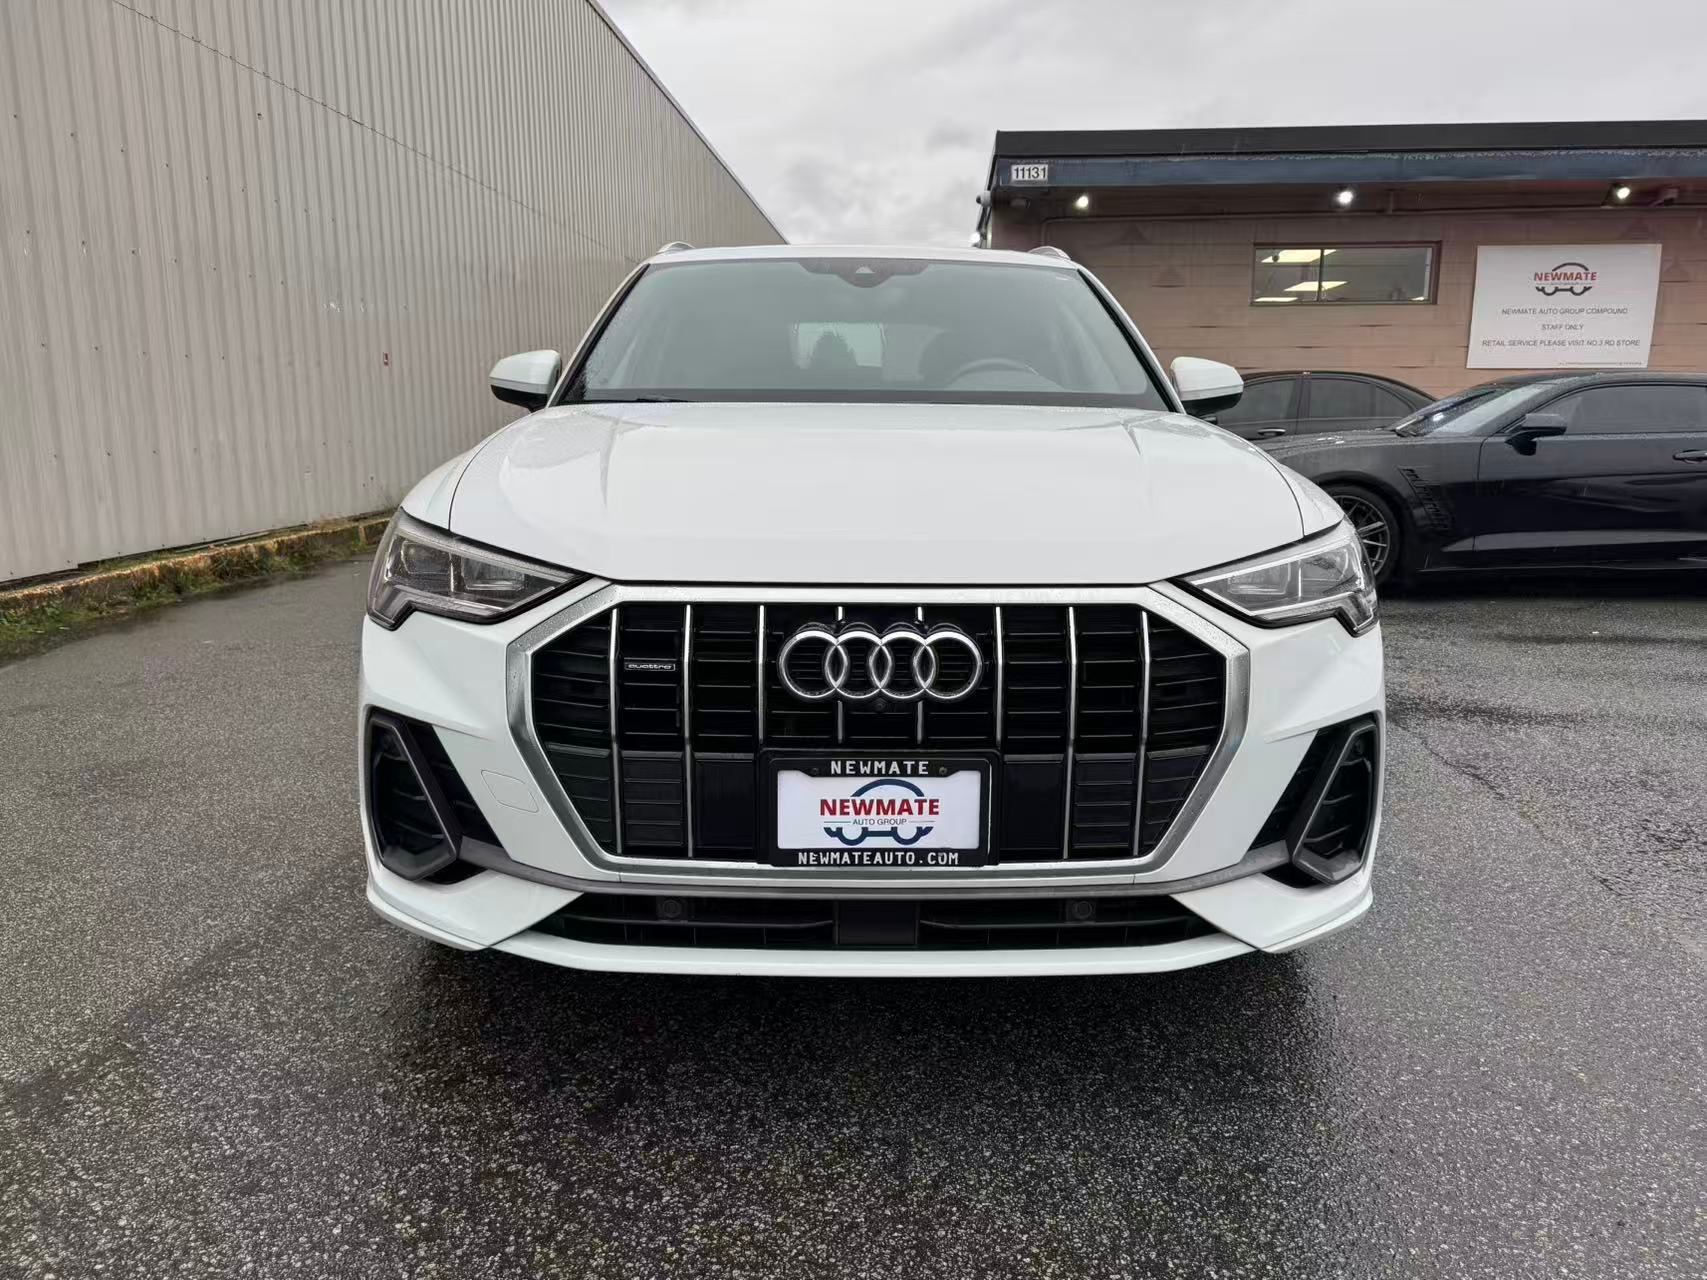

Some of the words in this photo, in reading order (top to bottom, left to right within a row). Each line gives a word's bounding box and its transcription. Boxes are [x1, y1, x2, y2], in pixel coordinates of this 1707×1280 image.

[1014, 166, 1046, 179] 11131
[1534, 271, 1597, 281] NEWMATE
[830, 760, 930, 775] NEWMATE
[820, 799, 940, 816] NEWMATE
[853, 818, 876, 826] AUTO
[877, 818, 907, 826] GROUP
[798, 851, 959, 865] NEWMATEAUTO.COM
